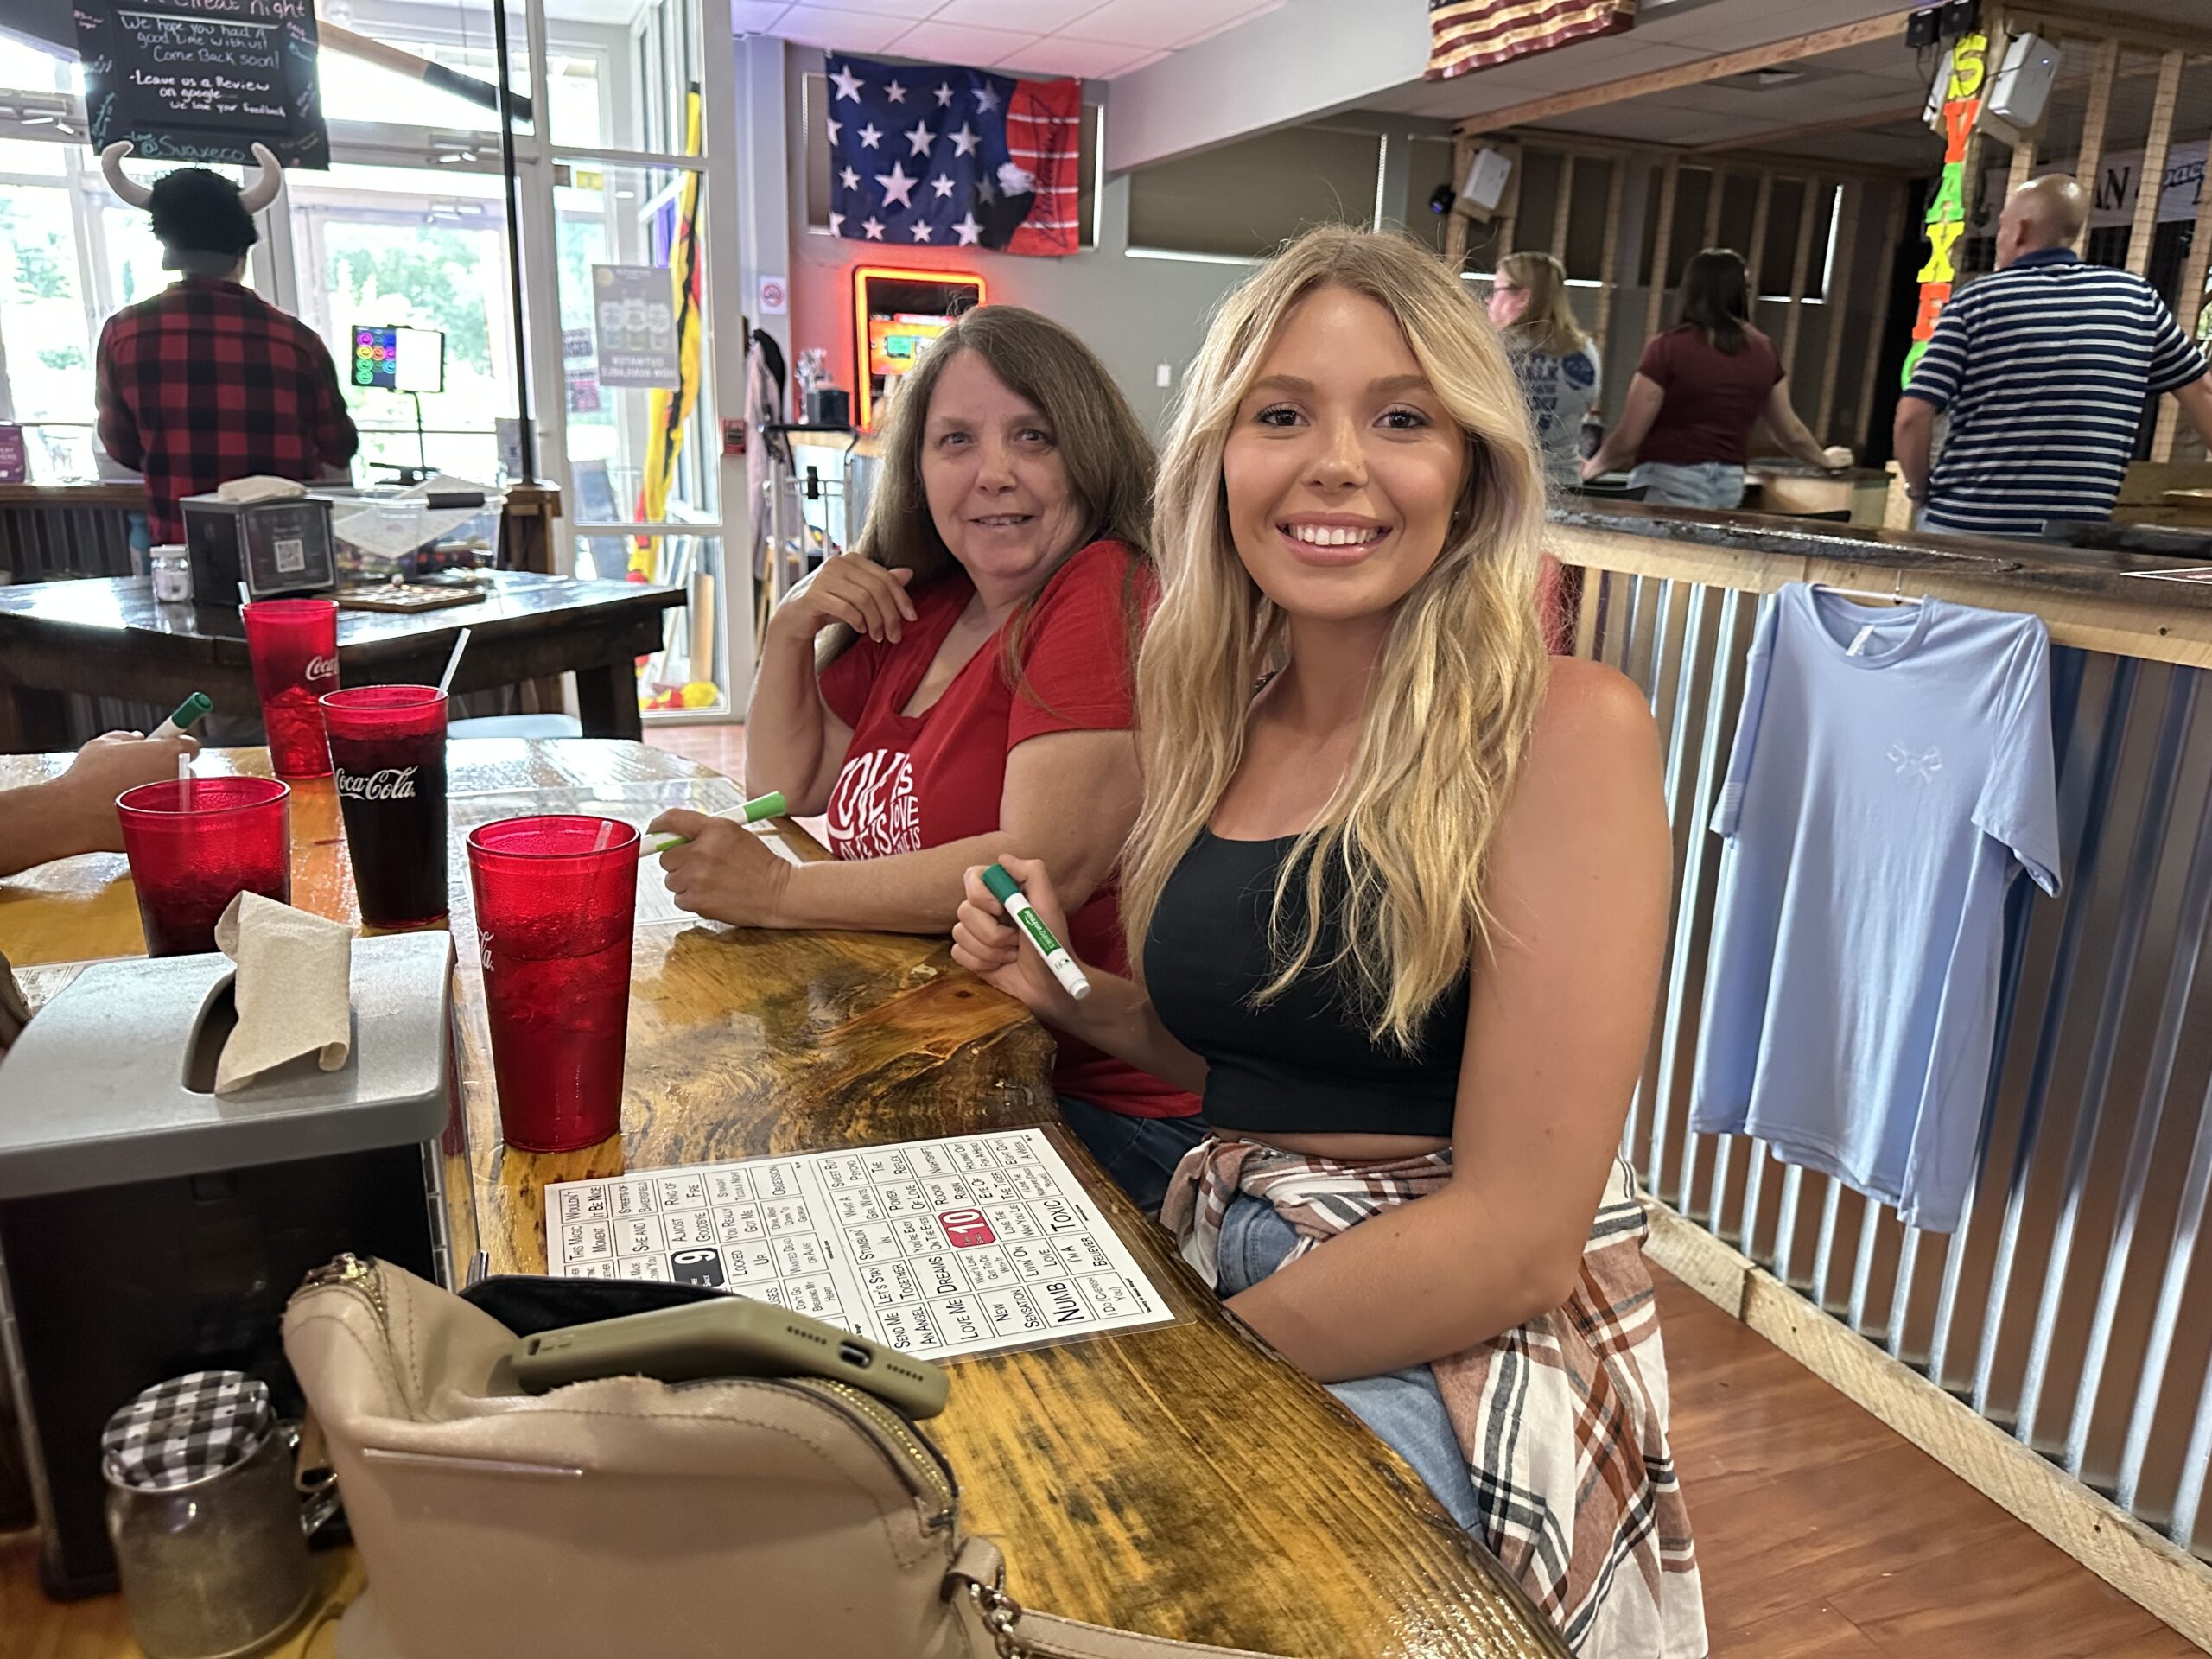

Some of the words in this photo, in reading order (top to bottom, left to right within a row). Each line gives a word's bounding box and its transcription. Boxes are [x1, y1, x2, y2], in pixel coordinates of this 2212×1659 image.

[1899, 33, 1988, 392] SVAXE
[336, 766, 419, 801] Coca-Cola
[827, 749, 906, 841] LOVE
[890, 753, 913, 803] IS
[889, 795, 919, 846] LOVE
[823, 1160, 838, 1170] BUT
[870, 1160, 885, 1173] THE
[890, 1154, 907, 1175] REFLEX
[919, 1147, 942, 1174] NIGHTSHIFT
[846, 1160, 863, 1181] PSYCHO
[768, 1166, 786, 1196] OBSESSION
[829, 1170, 845, 1188] SWEET
[970, 1178, 986, 1186] OF
[990, 1171, 1007, 1188] TIGER
[587, 1186, 602, 1202] NICE
[664, 1190, 679, 1206] RING
[685, 1184, 702, 1198] FIRE
[858, 1188, 873, 1207] WANTS
[905, 1184, 921, 1200] LOVE
[925, 1183, 949, 1205] ROCKIN'
[951, 1182, 968, 1200] ROBIN
[978, 1186, 994, 1199] EYE
[1000, 1187, 1014, 1200] THE
[563, 1191, 581, 1221] WOULDN'T
[588, 1201, 604, 1211] BE
[618, 1192, 632, 1214] STREETS
[885, 1189, 904, 1211] POWER
[910, 1200, 925, 1210] OF
[740, 1209, 754, 1220] ME
[842, 1202, 857, 1218] WHAT
[865, 1205, 879, 1220] GIRL
[995, 1210, 1007, 1222] THE
[1008, 1204, 1020, 1213] LIE
[1043, 1199, 1076, 1232] TOXIC
[721, 1208, 735, 1228] REALLY
[918, 1217, 932, 1230] EYES
[943, 1211, 985, 1234] 10
[1014, 1212, 1027, 1225] YOU
[632, 1222, 647, 1236] AND
[671, 1218, 687, 1242] ALMOST
[694, 1212, 711, 1243] GOODBYE
[724, 1227, 739, 1242] YOU
[743, 1220, 759, 1233] GOT
[903, 1221, 916, 1234] EASY
[1001, 1220, 1016, 1235] LOVE
[1021, 1224, 1034, 1236] WAY
[568, 1225, 583, 1246] MAGIC
[592, 1228, 607, 1253] MOMENT
[877, 1236, 893, 1245] IN
[908, 1233, 924, 1253] YOU'RE
[925, 1230, 938, 1242] THE
[632, 1236, 650, 1252] SHE
[782, 1237, 795, 1253] DEAD
[849, 1230, 874, 1261] STUMBLIN'
[929, 1240, 943, 1250] ON
[1012, 1245, 1028, 1258] ON
[1080, 1236, 1108, 1267] BELIEVER
[569, 1245, 584, 1261] THIS
[674, 1248, 716, 1264] 9
[978, 1254, 990, 1263] DO
[1039, 1249, 1058, 1268] LOVE
[1066, 1252, 1083, 1263] I'M
[730, 1249, 748, 1277] LOCKED
[787, 1252, 802, 1274] WANTED
[964, 1255, 977, 1268] LOVE
[982, 1262, 993, 1270] TO
[1016, 1259, 1040, 1278] LIVIN'
[868, 1268, 885, 1284] STAY
[892, 1263, 915, 1300] TOGETHER
[928, 1256, 957, 1294] DREAMS
[987, 1269, 999, 1280] GOT
[790, 1287, 802, 1296] GO
[823, 1287, 836, 1302] HEART
[873, 1284, 893, 1305] LET'S
[1108, 1286, 1126, 1302] YOU)
[945, 1299, 966, 1315] ME
[1011, 1288, 1040, 1328] SENSATION
[1046, 1282, 1084, 1323] NUMB
[1103, 1302, 1116, 1313] DO
[883, 1312, 902, 1326] ME
[912, 1306, 931, 1332] ANGEL
[993, 1303, 1011, 1322] NEW
[956, 1315, 979, 1340] LOVE
[893, 1326, 911, 1349] SEND
[919, 1332, 937, 1344] AN
